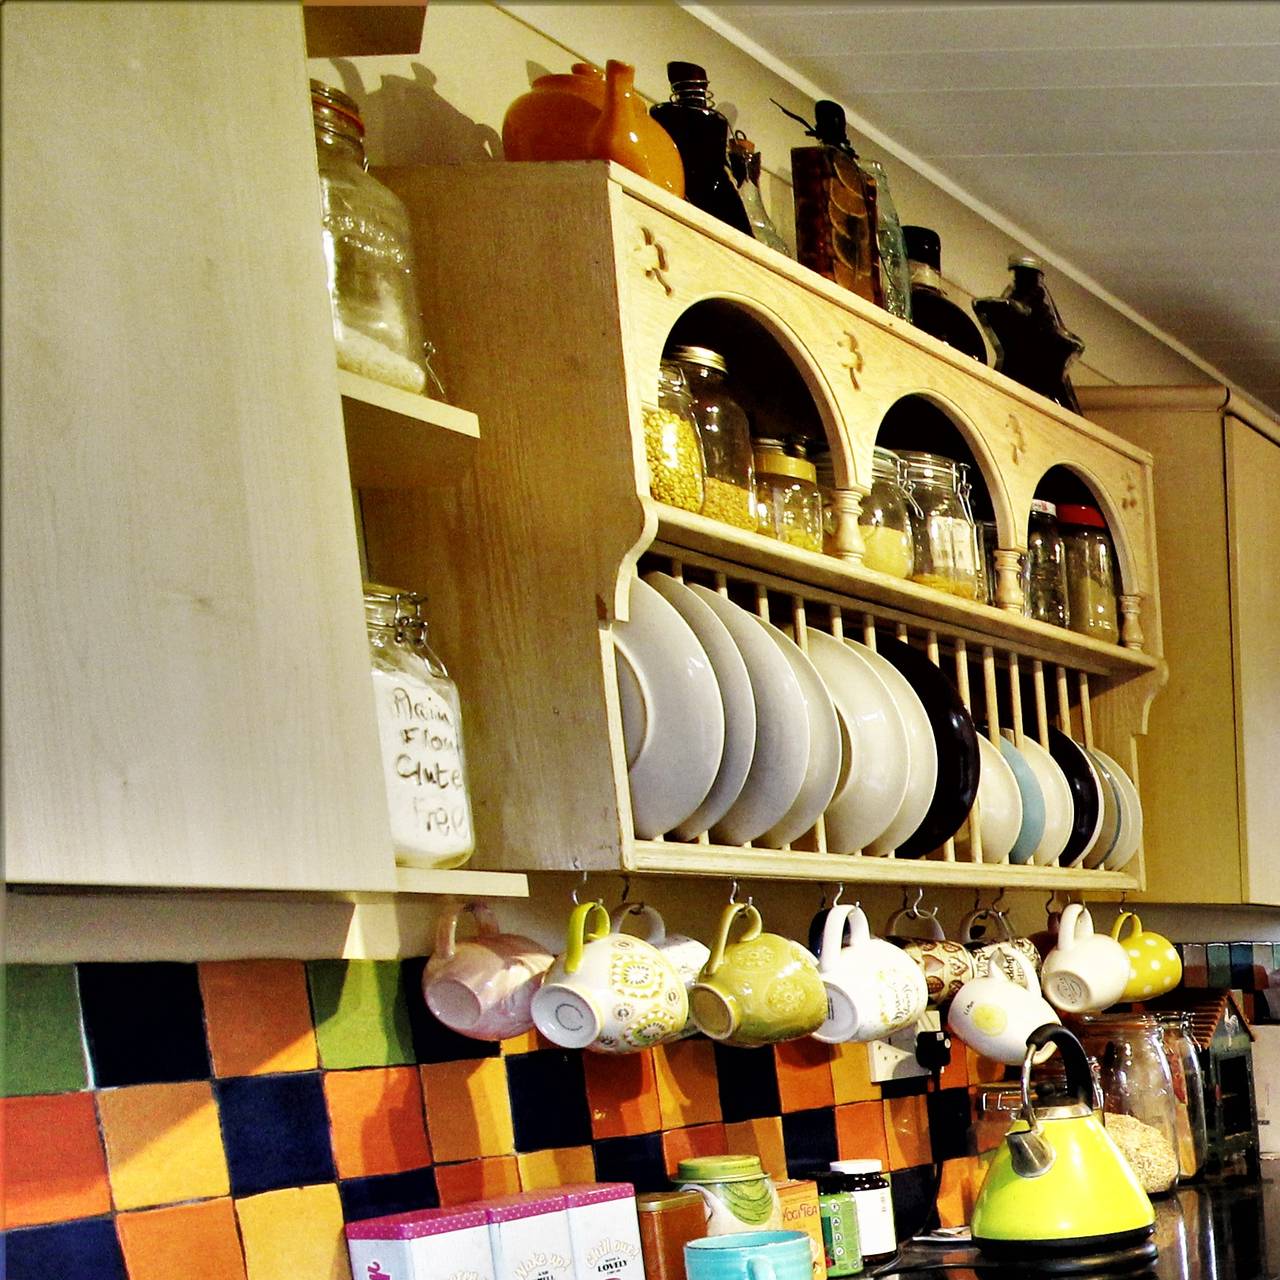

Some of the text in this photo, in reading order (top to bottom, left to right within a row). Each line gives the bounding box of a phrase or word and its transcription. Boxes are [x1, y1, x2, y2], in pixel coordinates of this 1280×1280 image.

[413, 797, 469, 838] Free
[800, 1203, 818, 1218] TEA
[513, 1252, 547, 1280] Wake
[586, 1239, 611, 1269] Chill
[597, 1260, 628, 1273] LOVELY
